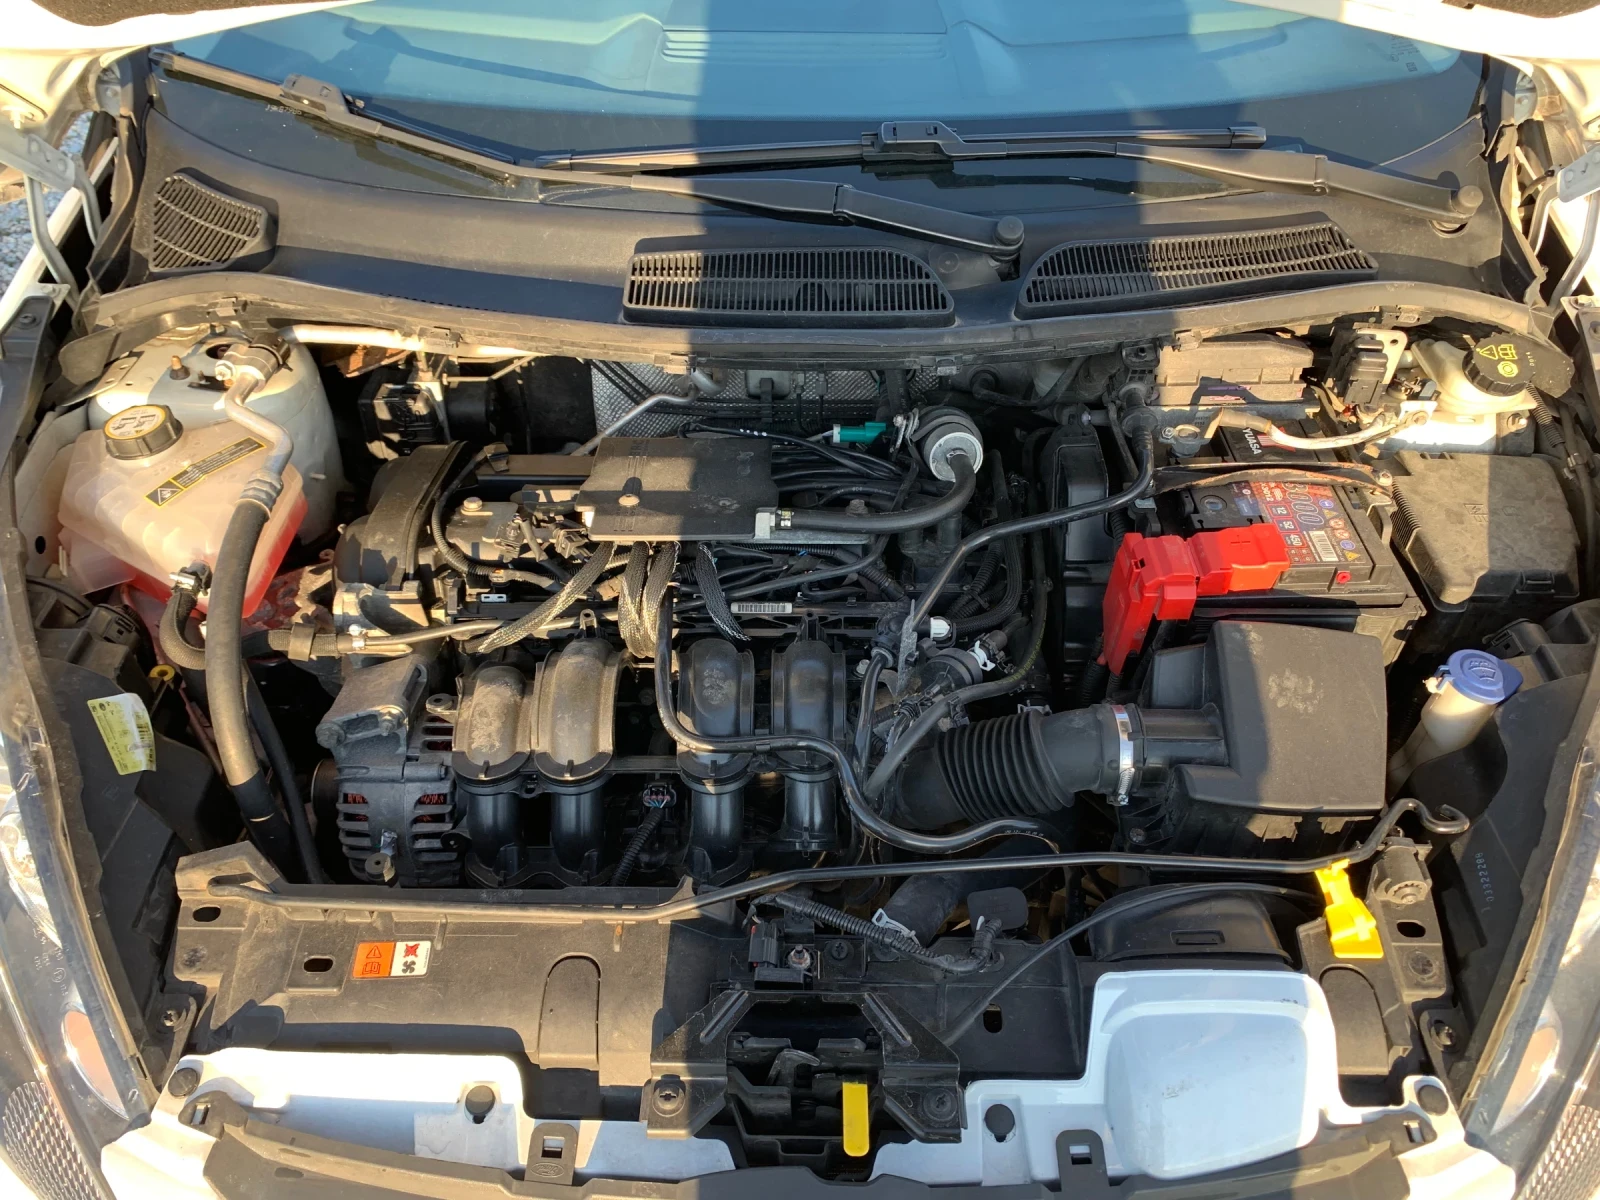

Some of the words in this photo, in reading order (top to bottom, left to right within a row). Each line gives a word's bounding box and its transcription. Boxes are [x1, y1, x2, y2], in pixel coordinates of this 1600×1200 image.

[1242, 427, 1263, 455] YUASA
[1283, 521, 1295, 530] 52
[1290, 534, 1303, 547] 450
